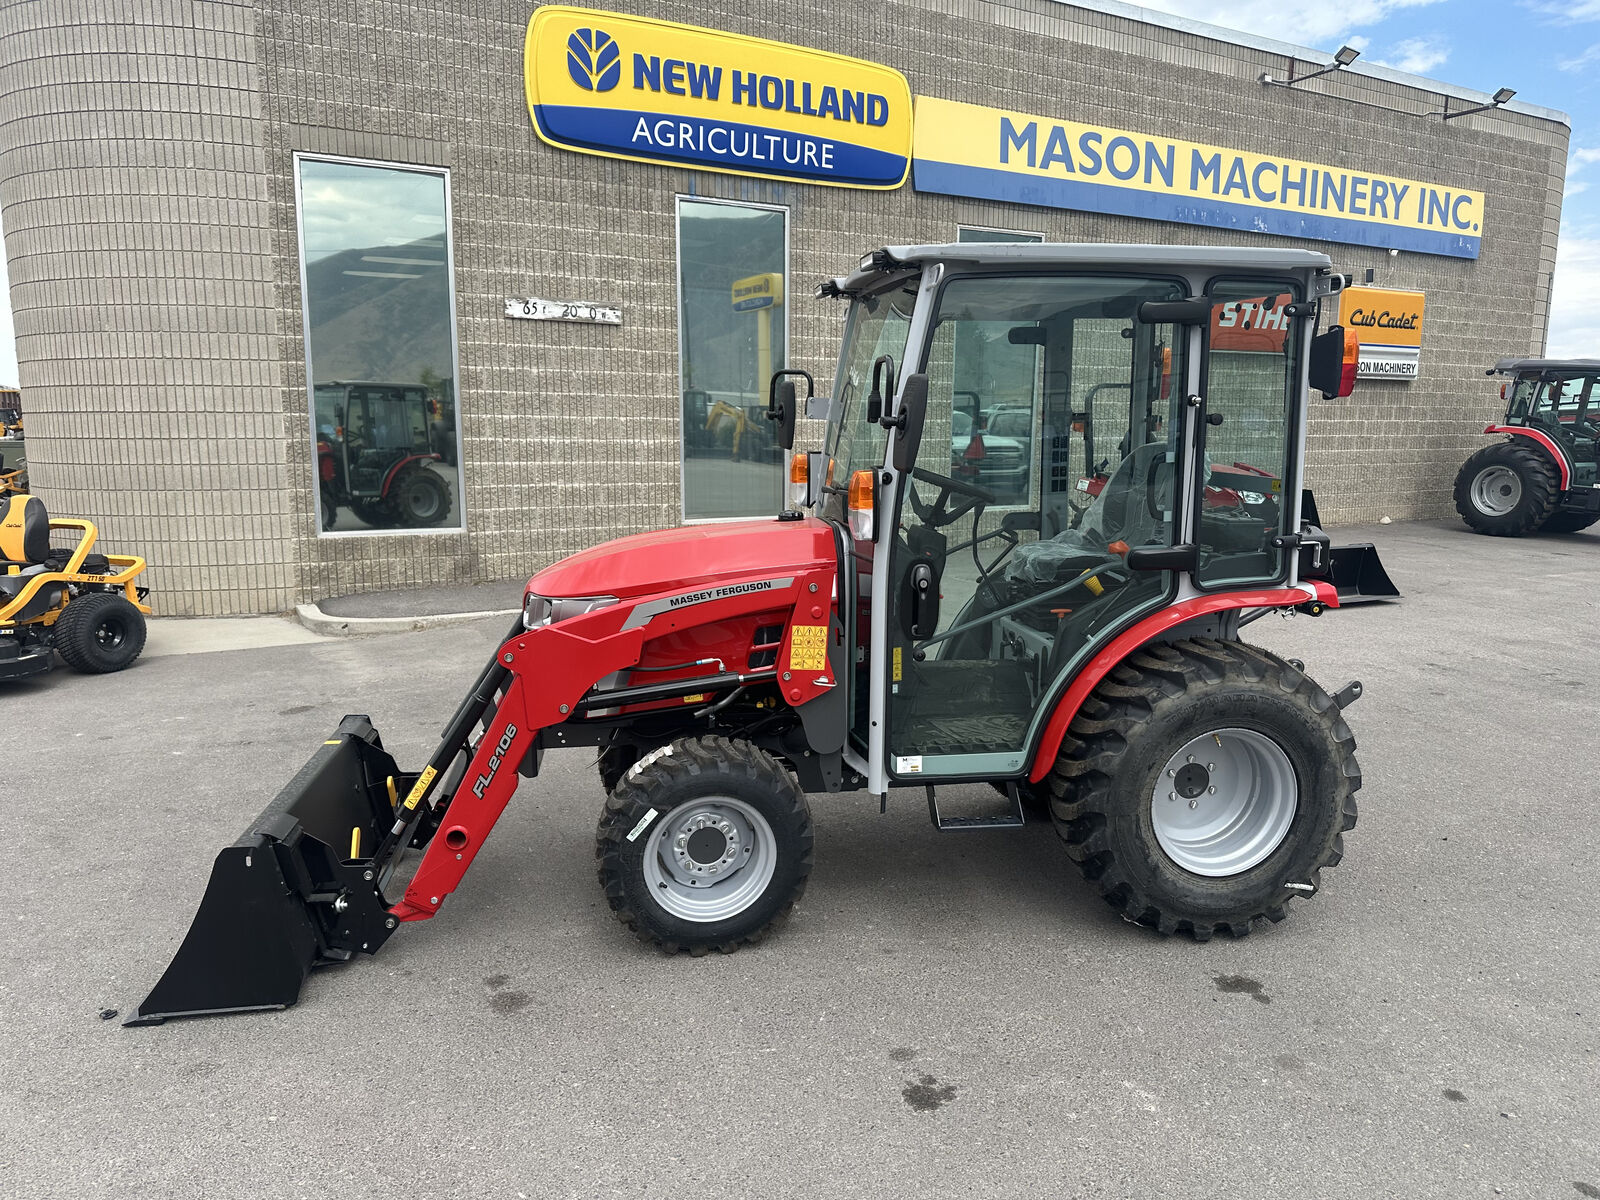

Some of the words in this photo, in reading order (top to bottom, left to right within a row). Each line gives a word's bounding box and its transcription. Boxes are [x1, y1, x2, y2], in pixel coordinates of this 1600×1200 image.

[633, 53, 722, 100] NEW
[732, 70, 889, 127] HOLLAND
[632, 117, 834, 169] AGRICULTURE
[999, 117, 1175, 188] MASON
[1190, 149, 1409, 220] MACHINERY
[1417, 187, 1479, 232] INC.
[1350, 309, 1375, 327] Cub
[1377, 311, 1417, 330] Cadet
[1373, 362, 1416, 374] MACHINERY
[670, 591, 712, 607] MASSEY
[716, 581, 771, 598] FERGUSON
